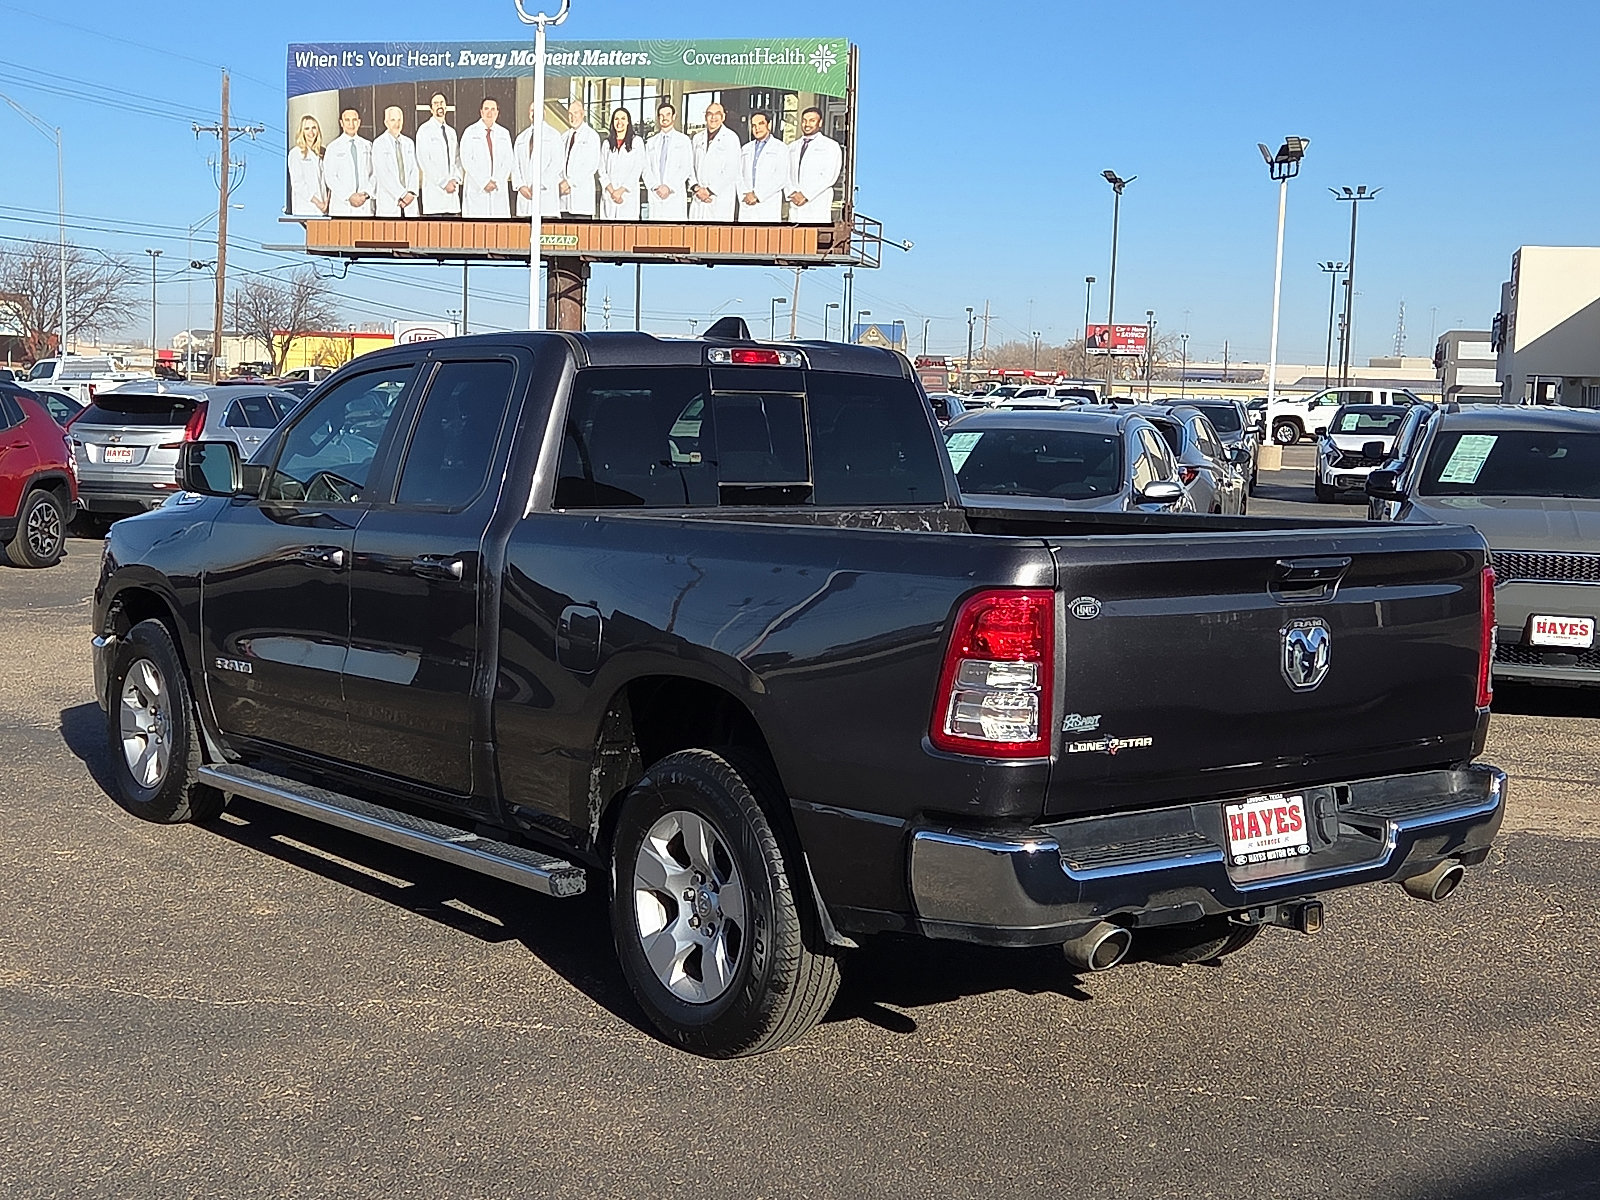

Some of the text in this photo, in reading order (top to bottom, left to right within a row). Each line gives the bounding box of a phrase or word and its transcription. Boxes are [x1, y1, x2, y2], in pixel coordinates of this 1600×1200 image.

[295, 51, 338, 68] When
[341, 50, 364, 67] It's
[368, 50, 403, 67] Your
[407, 50, 455, 69] Heart,
[457, 50, 506, 69] Every
[581, 50, 651, 67] Matters.
[682, 47, 806, 66] CovenantHealth
[1293, 619, 1322, 628] RAM
[1537, 622, 1588, 636] HAYES
[1068, 737, 1153, 753] LONE STAR
[1229, 805, 1302, 841] HAYES
